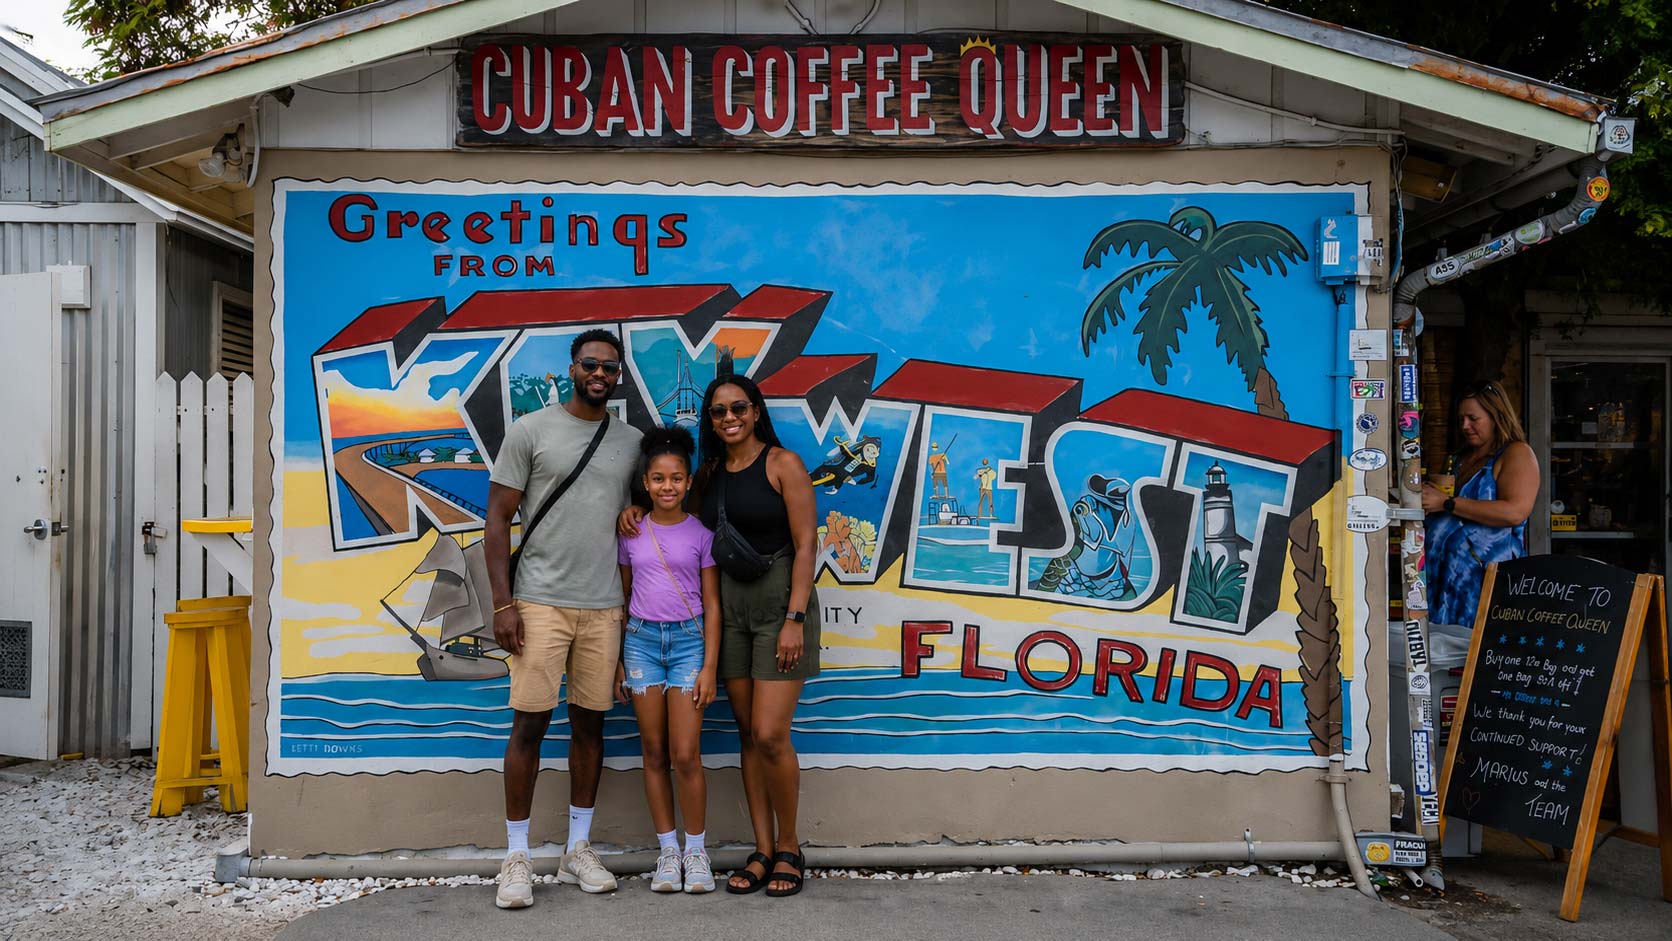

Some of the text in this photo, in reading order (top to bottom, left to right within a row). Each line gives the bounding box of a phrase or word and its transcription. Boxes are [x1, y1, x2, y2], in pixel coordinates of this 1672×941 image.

[471, 42, 1168, 139] CUBAN COFFEE QUEEN
[434, 254, 555, 277] FROM
[757, 354, 1338, 634] WEST
[1507, 573, 1611, 607] WELCOME TO
[824, 606, 863, 624] ITY
[1491, 605, 1611, 635] CUBAN COFFEE QUEEN
[901, 620, 1283, 729] FLORIDA
[1485, 649, 1504, 670] Buy
[1504, 656, 1522, 666] one
[1543, 659, 1557, 676] Bag
[1579, 666, 1596, 679] get
[1515, 672, 1532, 688] Bag
[1473, 703, 1586, 736] We thank you for your
[1470, 726, 1525, 747] CONTINUED
[1470, 756, 1529, 786] MARIUS
[1552, 780, 1566, 792] the
[1525, 793, 1570, 826] TEAM
